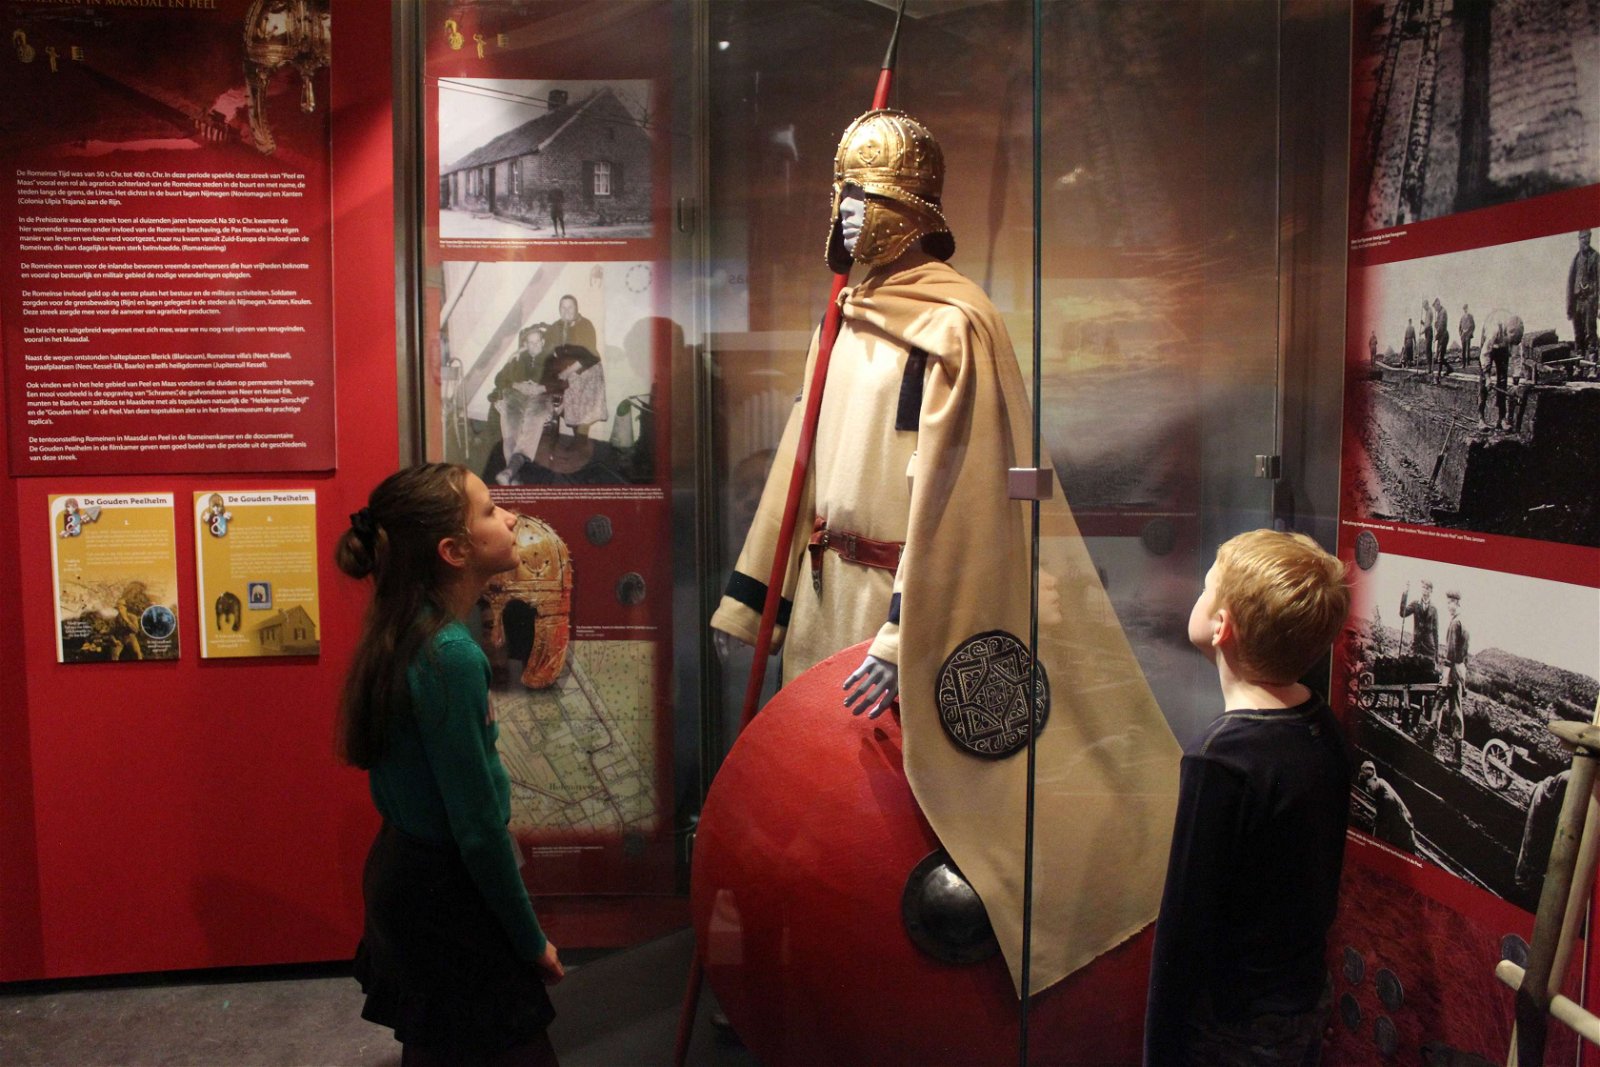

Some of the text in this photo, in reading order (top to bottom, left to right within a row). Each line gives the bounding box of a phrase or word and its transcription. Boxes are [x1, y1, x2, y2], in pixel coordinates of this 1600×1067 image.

[18, 197, 44, 206] (Colonia
[44, 197, 61, 207] Ulpia
[62, 197, 86, 207] Trajana)
[172, 216, 187, 226] jaren
[282, 225, 299, 235] eigen
[221, 234, 257, 244] Zuid-Europa
[78, 243, 108, 253] dagelijkse
[254, 262, 281, 271] vrijheden
[60, 271, 92, 280] bestuurlijk
[124, 271, 146, 280] gebied
[155, 271, 177, 280] nodige
[178, 271, 221, 280] veranderingen
[70, 326, 101, 335] uitgebreid
[102, 325, 132, 335] wegennet
[209, 326, 221, 334] nog
[235, 326, 256, 334] sporen
[38, 434, 84, 445] tentoonstelling
[85, 434, 116, 442] Romeinen
[124, 434, 149, 442] Maasdal
[157, 433, 171, 441] Peel
[187, 432, 235, 441] Romeinenkamer
[253, 432, 293, 440] documentaire
[39, 444, 64, 452] Gouden
[64, 444, 92, 452] Peelhelm
[109, 443, 139, 451] filmkamer
[140, 444, 158, 452] geven
[171, 442, 187, 452] goed
[188, 442, 205, 450] beeld
[227, 442, 250, 451] periode
[269, 441, 306, 451] geschiedenis
